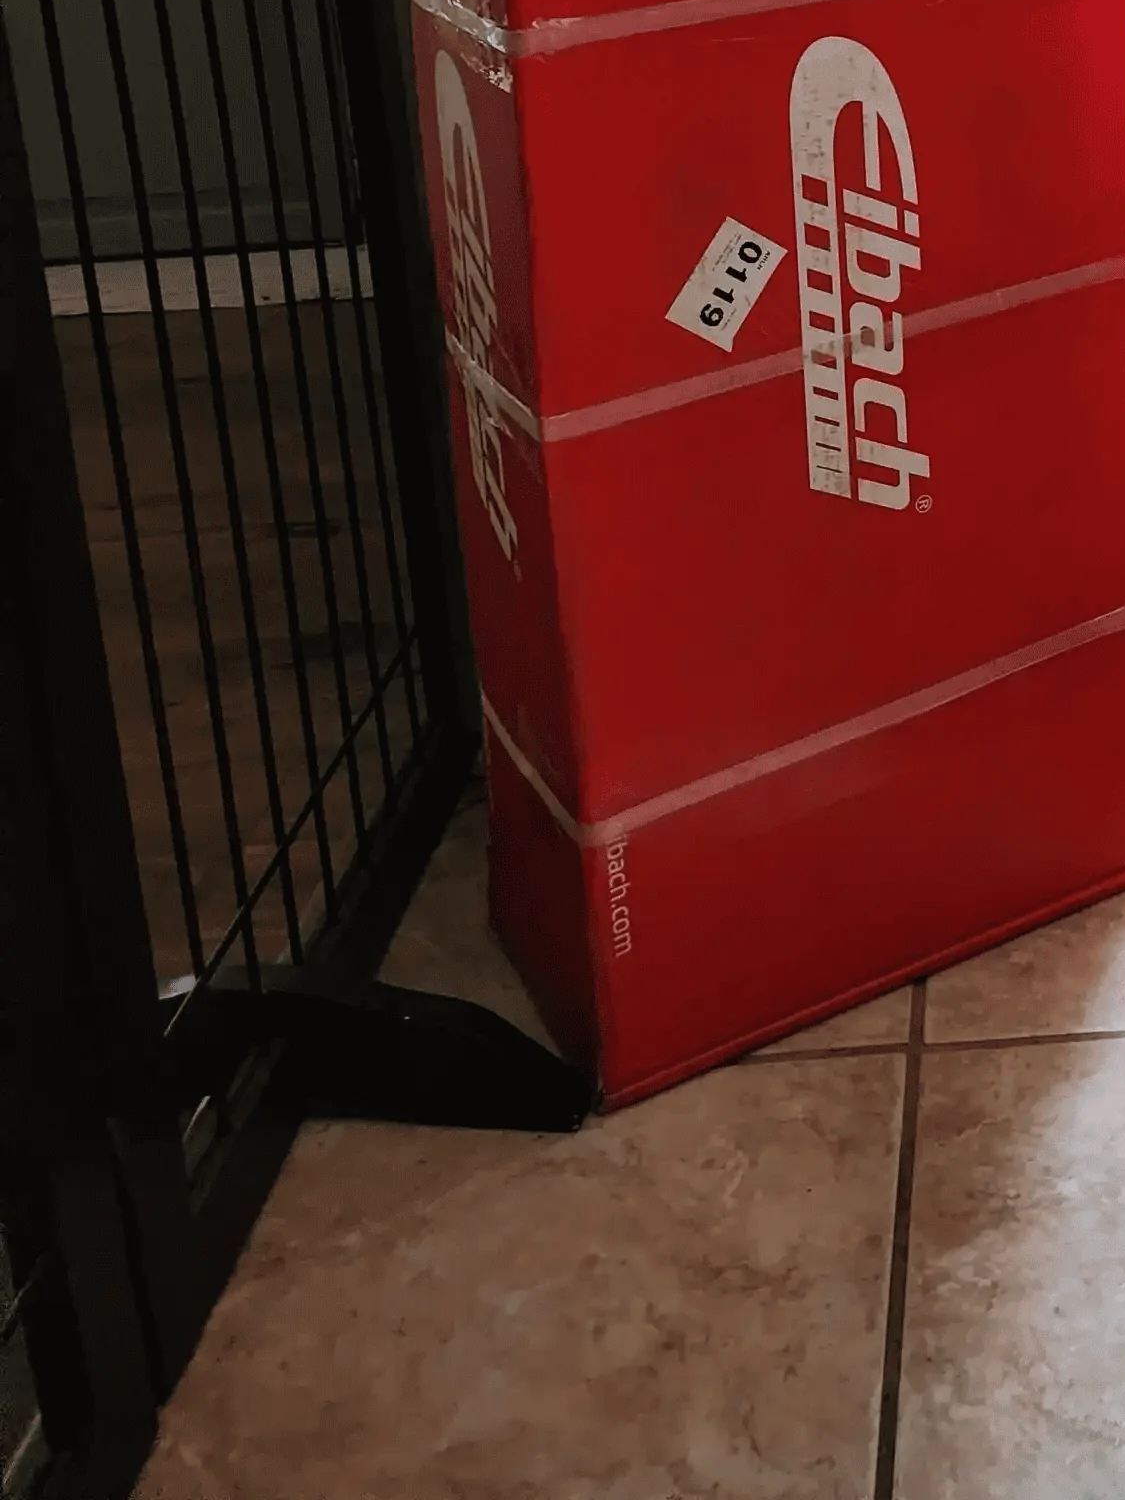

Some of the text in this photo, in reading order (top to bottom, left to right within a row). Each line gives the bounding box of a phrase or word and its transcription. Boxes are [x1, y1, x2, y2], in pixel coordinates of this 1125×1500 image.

[700, 241, 763, 327] 0119
[789, 35, 932, 510] Eibach
[606, 835, 633, 958] ibach.com
